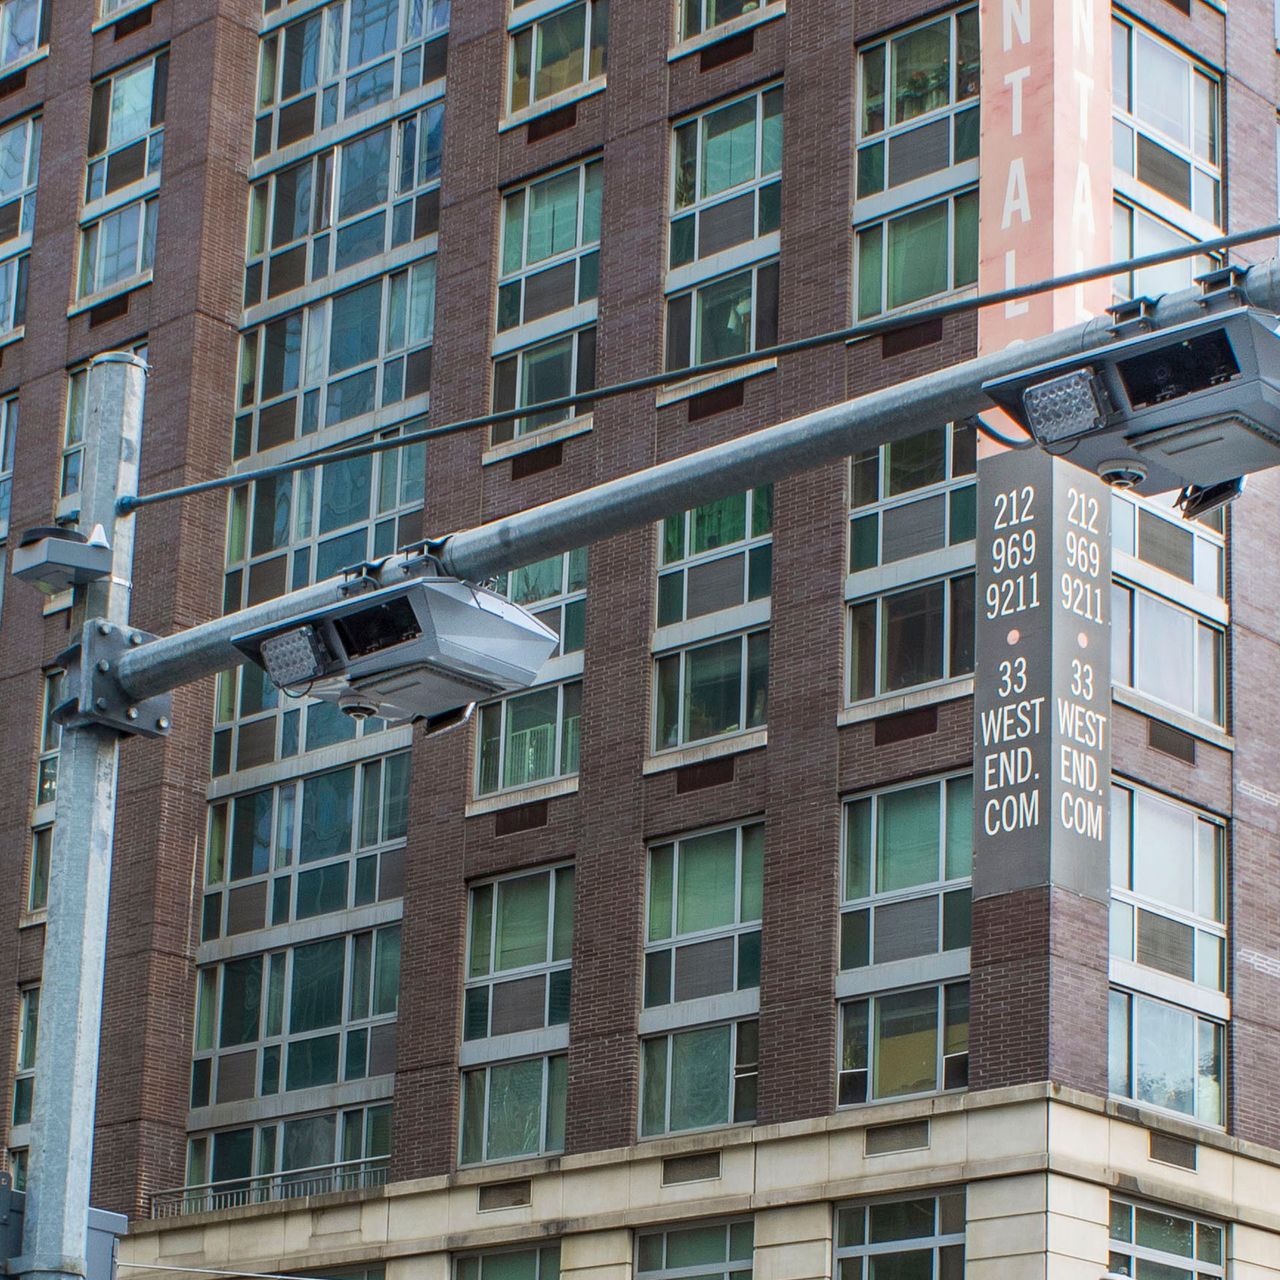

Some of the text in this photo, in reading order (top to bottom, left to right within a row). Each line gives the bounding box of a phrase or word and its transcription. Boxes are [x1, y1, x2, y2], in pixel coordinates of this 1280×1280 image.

[1001, 0, 1031, 344] NTAL
[994, 486, 1034, 530] 212
[1067, 487, 1099, 534] 212
[992, 529, 1036, 573] 969
[1066, 531, 1100, 577] 969
[986, 571, 1040, 619] 9211
[1061, 573, 1103, 624] 9211
[998, 657, 1027, 697] 33
[1071, 659, 1093, 700] 33
[981, 697, 1045, 746] WEST
[1058, 698, 1107, 750] WEST
[985, 747, 1039, 792] END.
[1061, 745, 1103, 796] END.
[985, 789, 1039, 836] COM
[1061, 792, 1103, 841] COM
